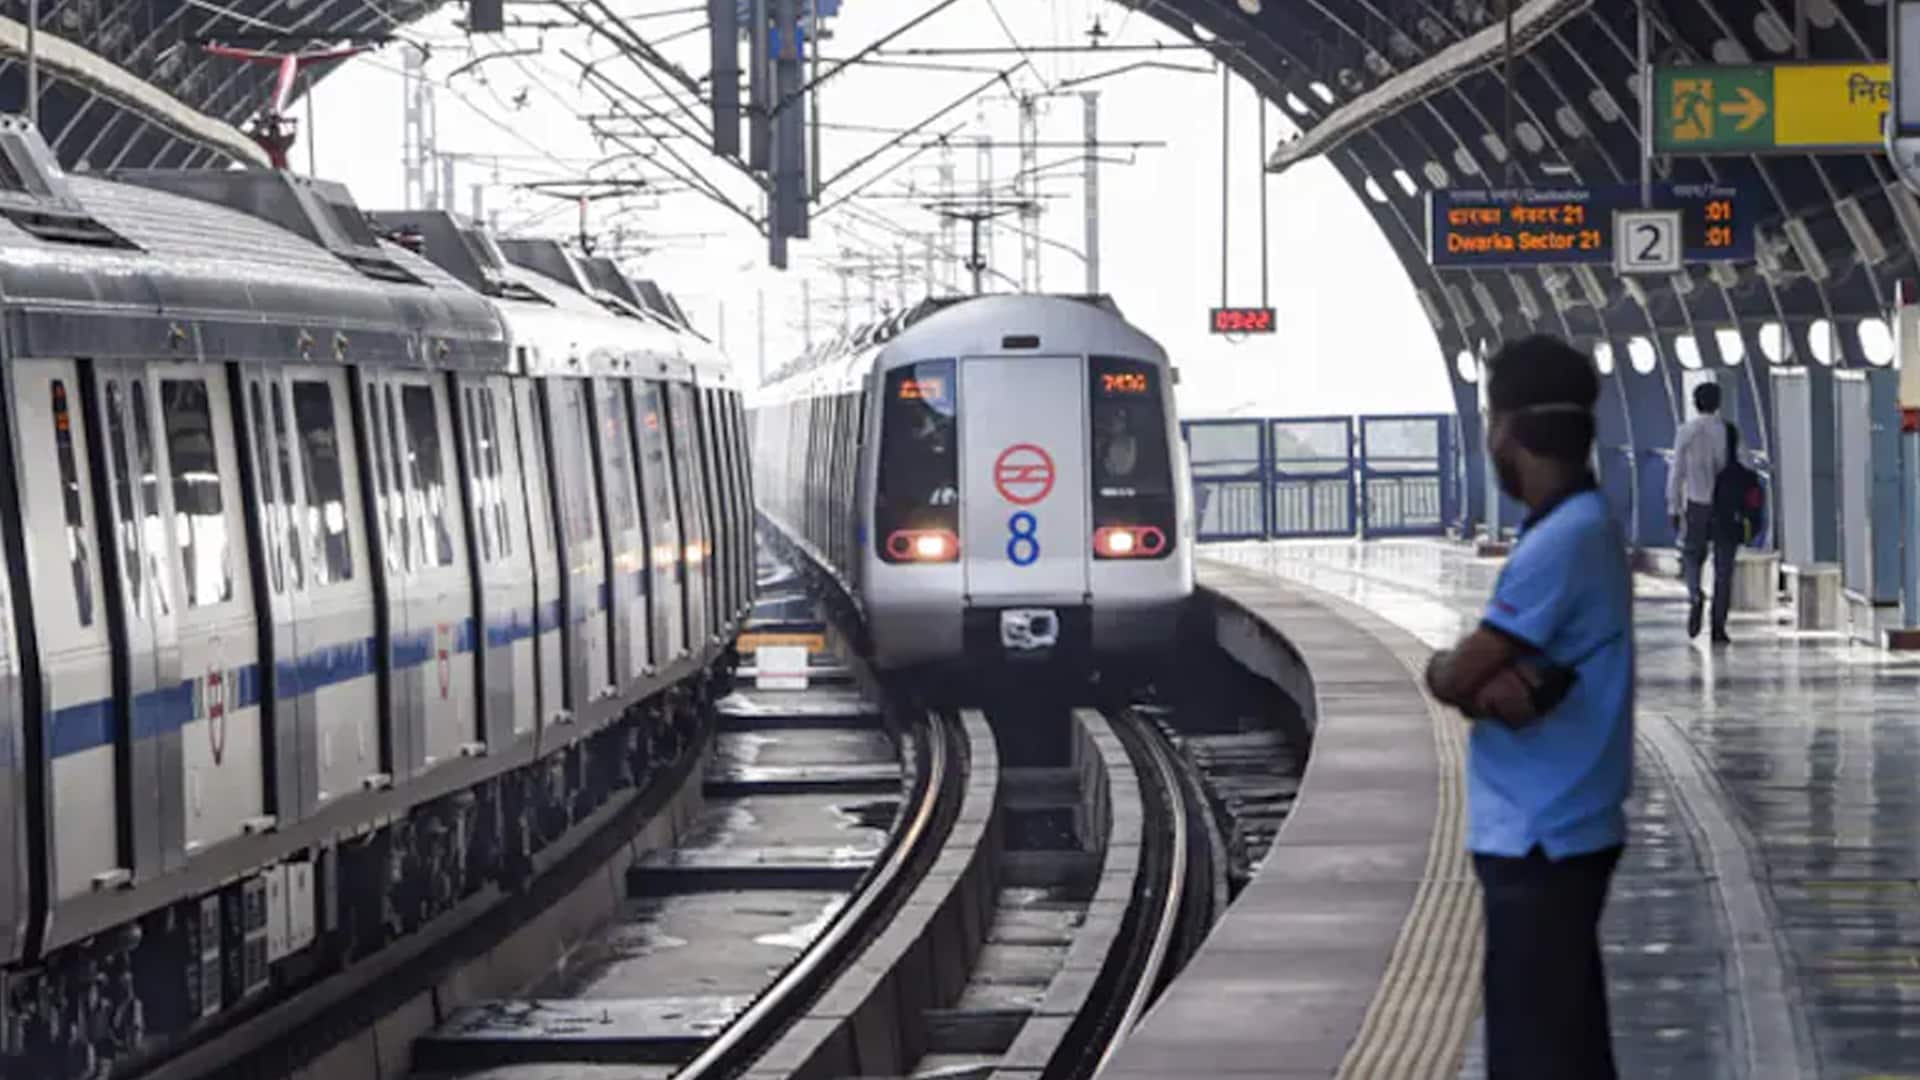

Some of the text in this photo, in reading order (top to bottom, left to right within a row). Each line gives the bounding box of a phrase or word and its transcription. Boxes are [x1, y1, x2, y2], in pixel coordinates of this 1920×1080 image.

[1563, 203, 1584, 224] 21
[1447, 229, 1600, 252] Dwarka Sector 21
[1636, 224, 1661, 261] 2
[1006, 511, 1040, 567] 8
